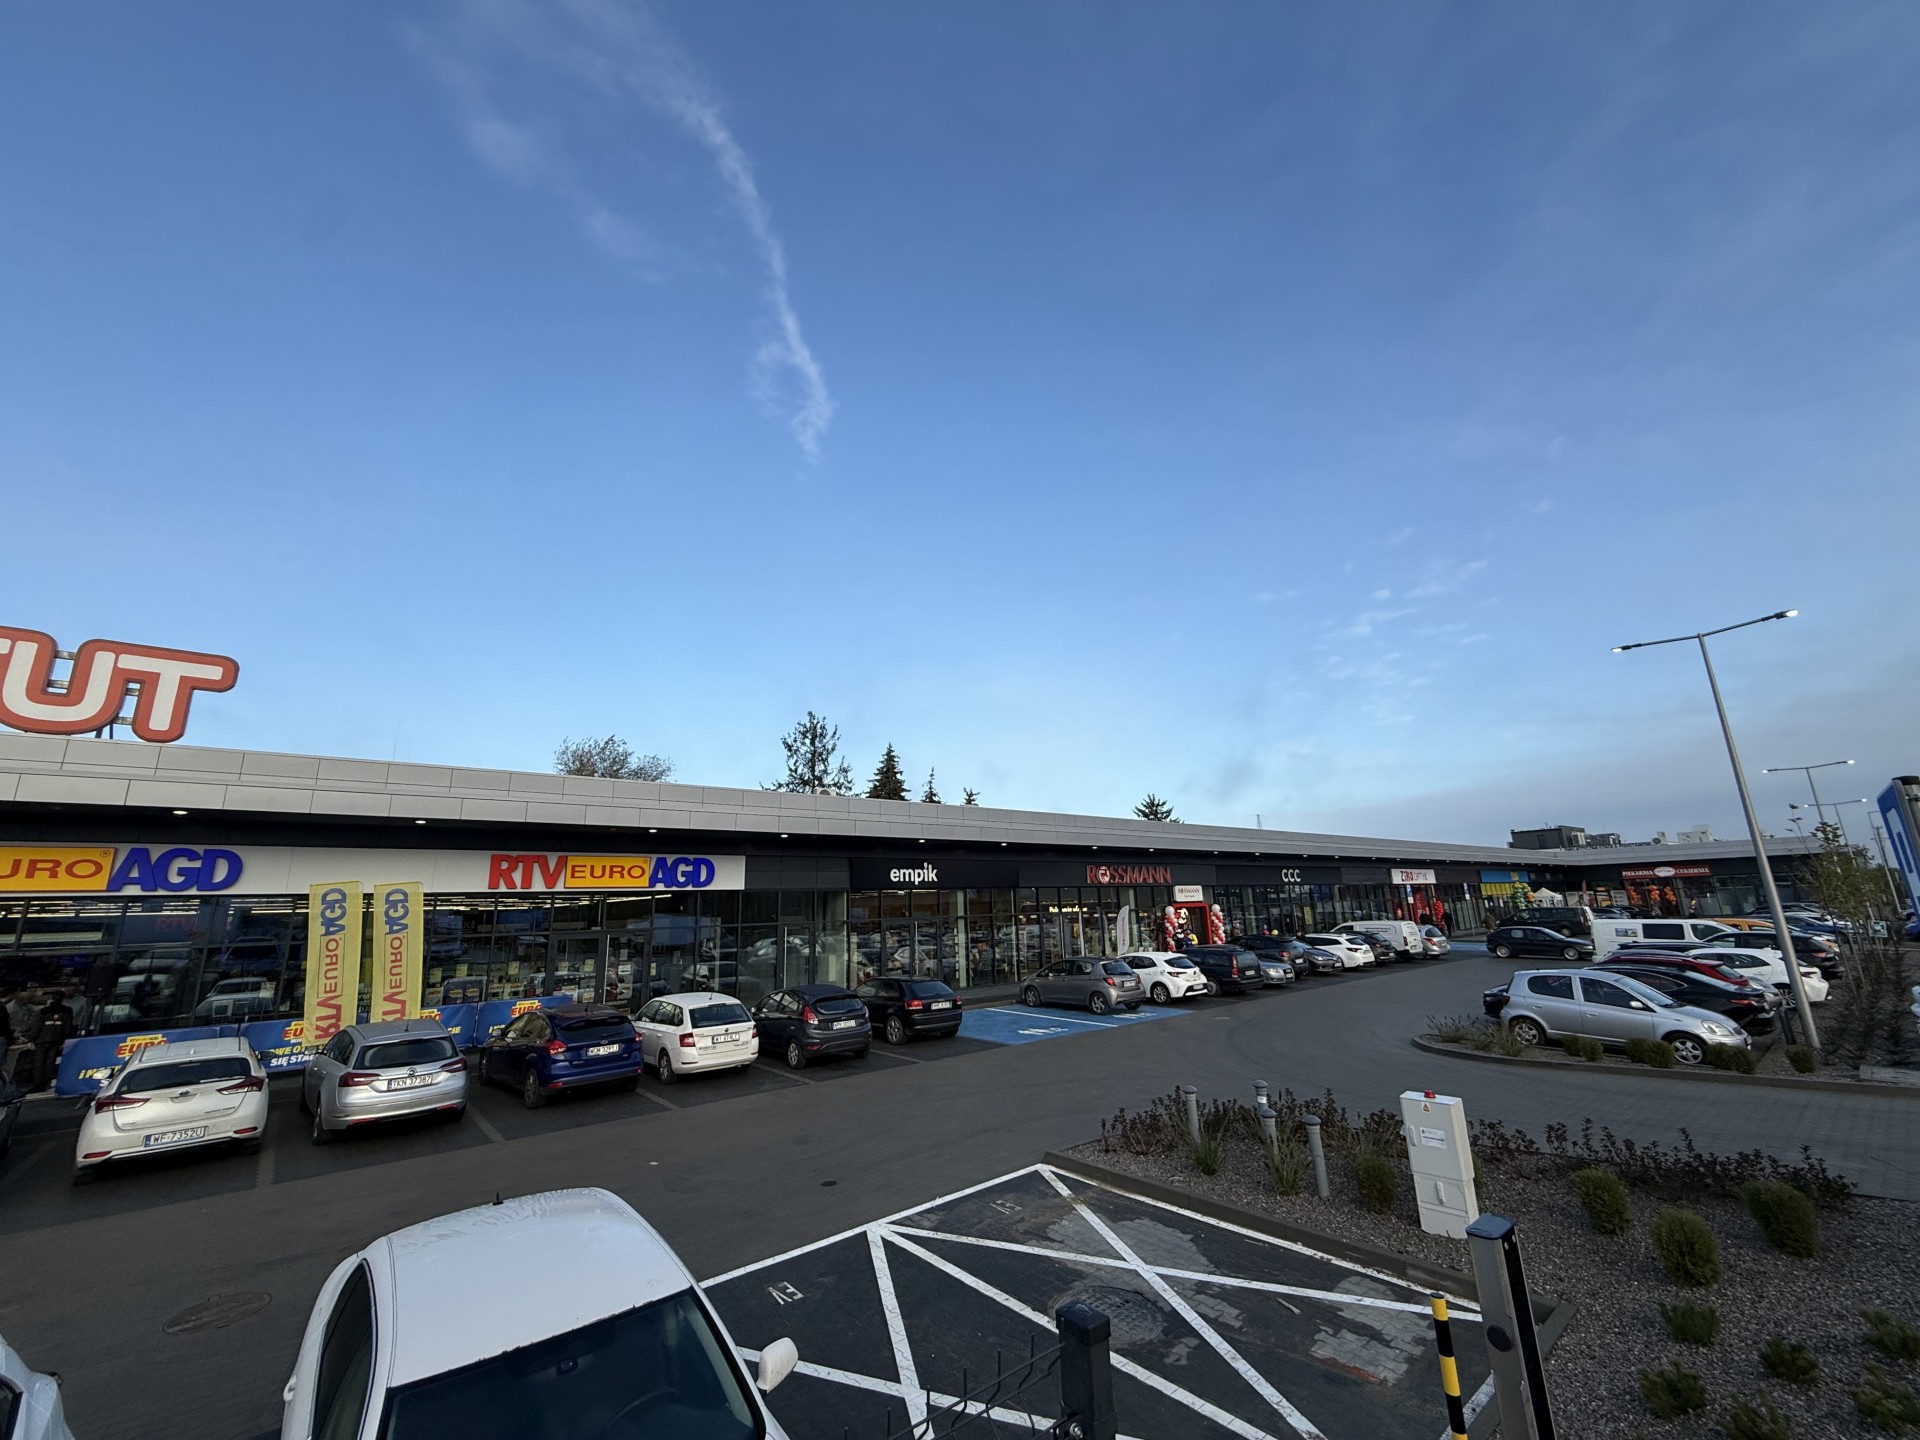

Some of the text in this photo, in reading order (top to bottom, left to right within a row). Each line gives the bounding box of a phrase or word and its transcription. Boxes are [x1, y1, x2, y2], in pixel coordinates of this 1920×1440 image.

[0, 626, 240, 743] UT
[106, 848, 243, 892] AGD
[488, 854, 715, 889] RTV EURO AGD
[890, 862, 938, 885] empik
[1086, 864, 1172, 884] ROSSMANN
[1282, 869, 1301, 882] CCC
[283, 1027, 304, 1038] EU
[393, 1076, 431, 1088] TKN 37387
[171, 1129, 202, 1141] 7352U
